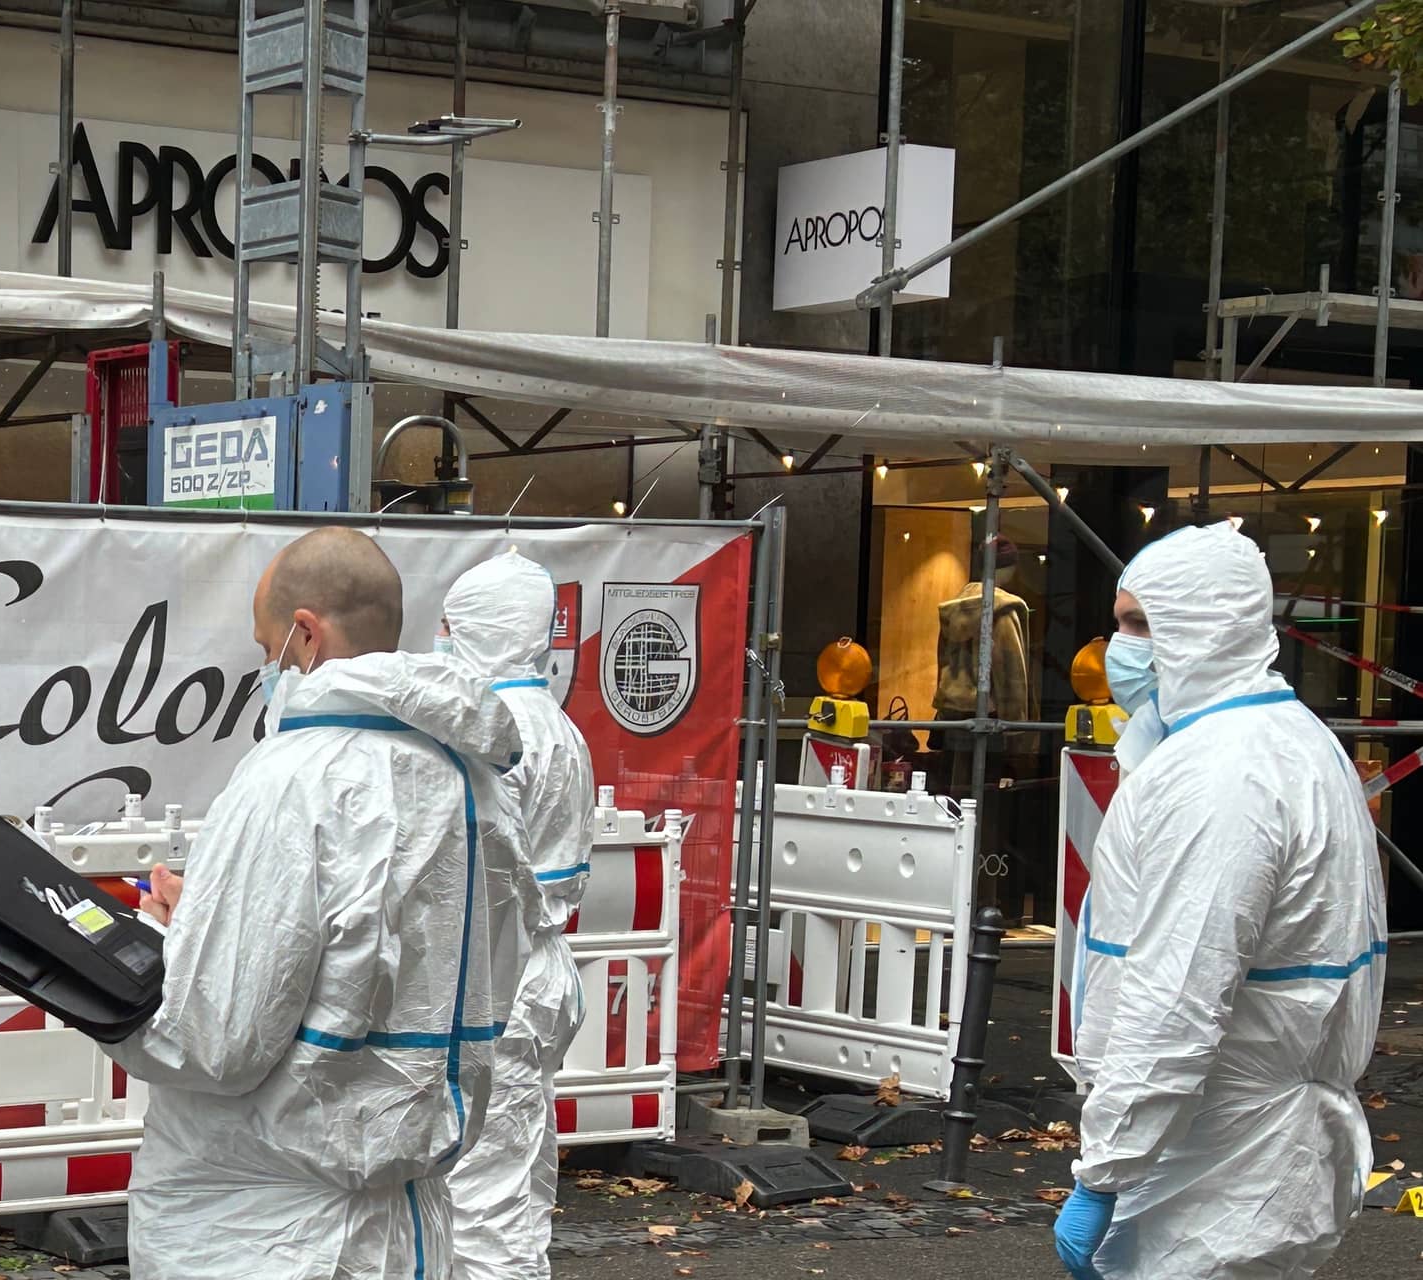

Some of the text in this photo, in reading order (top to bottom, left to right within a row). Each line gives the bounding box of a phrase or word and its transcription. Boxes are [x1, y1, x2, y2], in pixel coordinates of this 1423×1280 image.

[32, 121, 451, 279] APROOS
[783, 205, 886, 256] APROPO
[171, 427, 269, 470] GEDA
